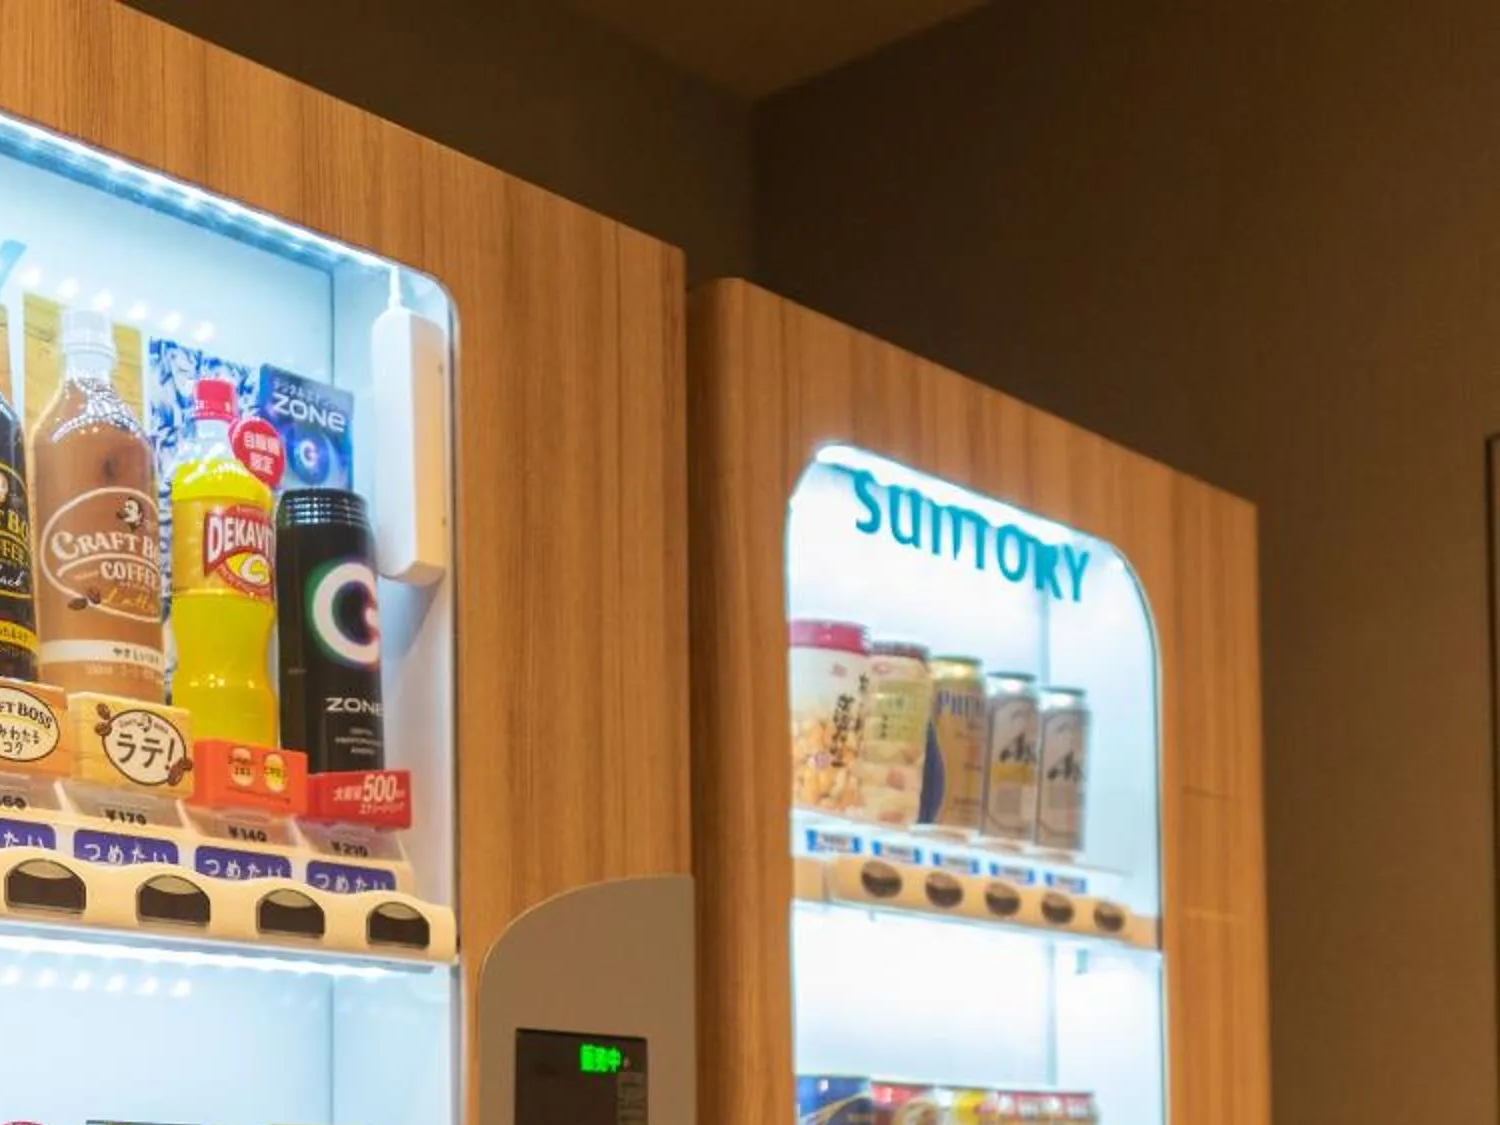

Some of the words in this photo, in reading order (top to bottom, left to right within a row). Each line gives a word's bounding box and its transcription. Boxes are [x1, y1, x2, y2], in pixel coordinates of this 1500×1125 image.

[52, 529, 145, 561] CRAFT
[850, 469, 1091, 604] SUNTORY
[17, 704, 53, 731] BOSS
[82, 841, 168, 865] つめたい
[203, 857, 283, 879] つめたい
